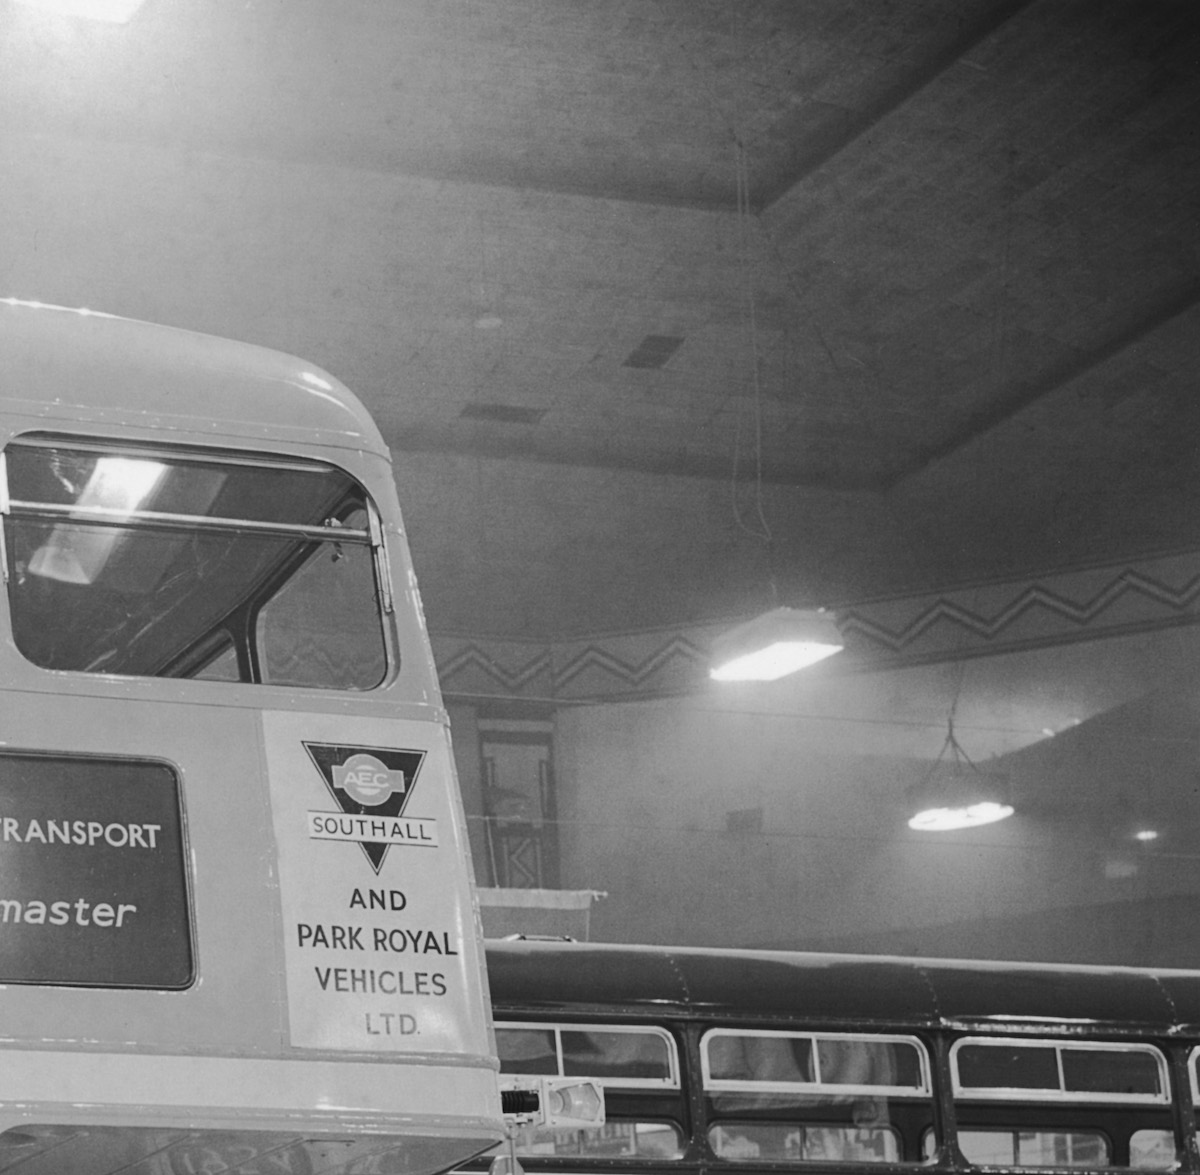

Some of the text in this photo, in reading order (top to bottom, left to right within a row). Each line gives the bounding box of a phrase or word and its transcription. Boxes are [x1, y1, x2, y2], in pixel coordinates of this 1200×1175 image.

[343, 771, 391, 789] AEC
[313, 816, 432, 840] SOUTHALL
[348, 888, 408, 912] AND
[297, 923, 459, 956] PARK ROYAL
[314, 966, 448, 997] VEHICLES
[365, 1013, 422, 1036] LTD.
